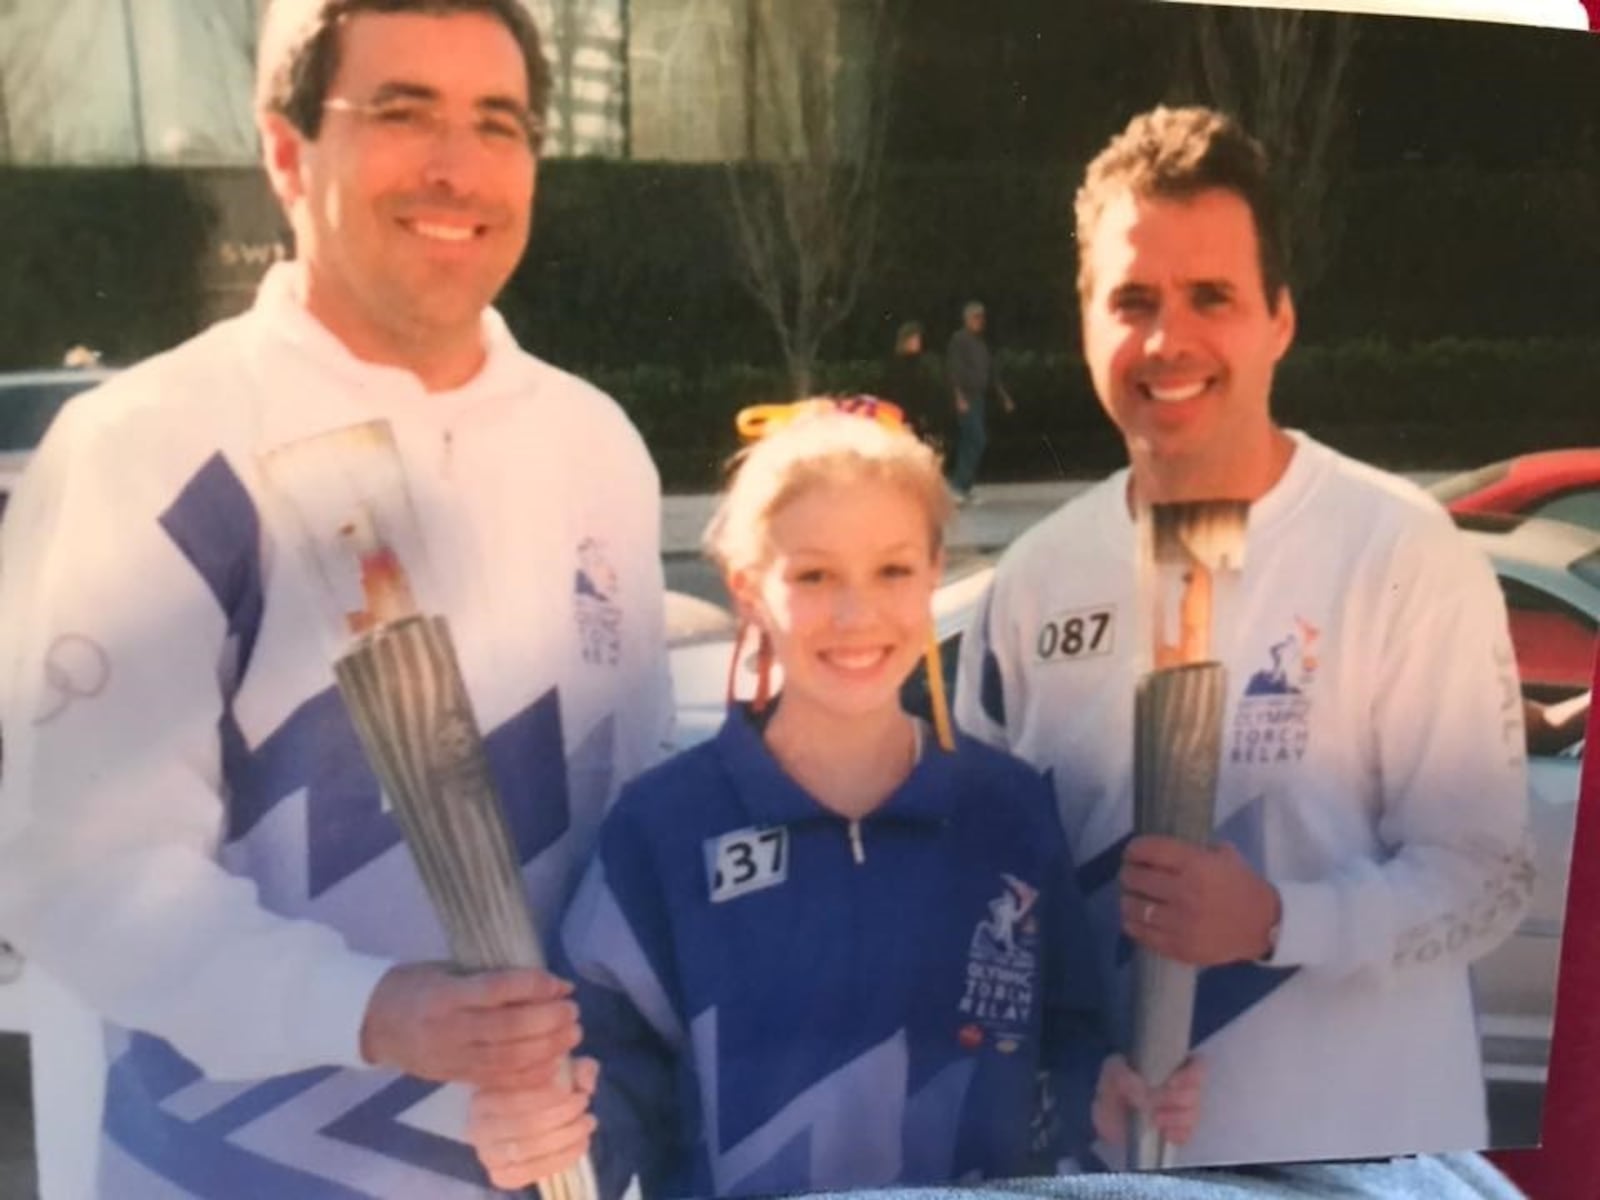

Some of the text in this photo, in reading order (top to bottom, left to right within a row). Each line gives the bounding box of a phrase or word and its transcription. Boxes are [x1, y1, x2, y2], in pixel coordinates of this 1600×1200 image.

[1037, 612, 1110, 659] 087
[1234, 728, 1309, 745] TORCH
[1231, 746, 1306, 765] RELAY
[966, 979, 1033, 1003] TORCH
[959, 996, 1031, 1022] RELAY
